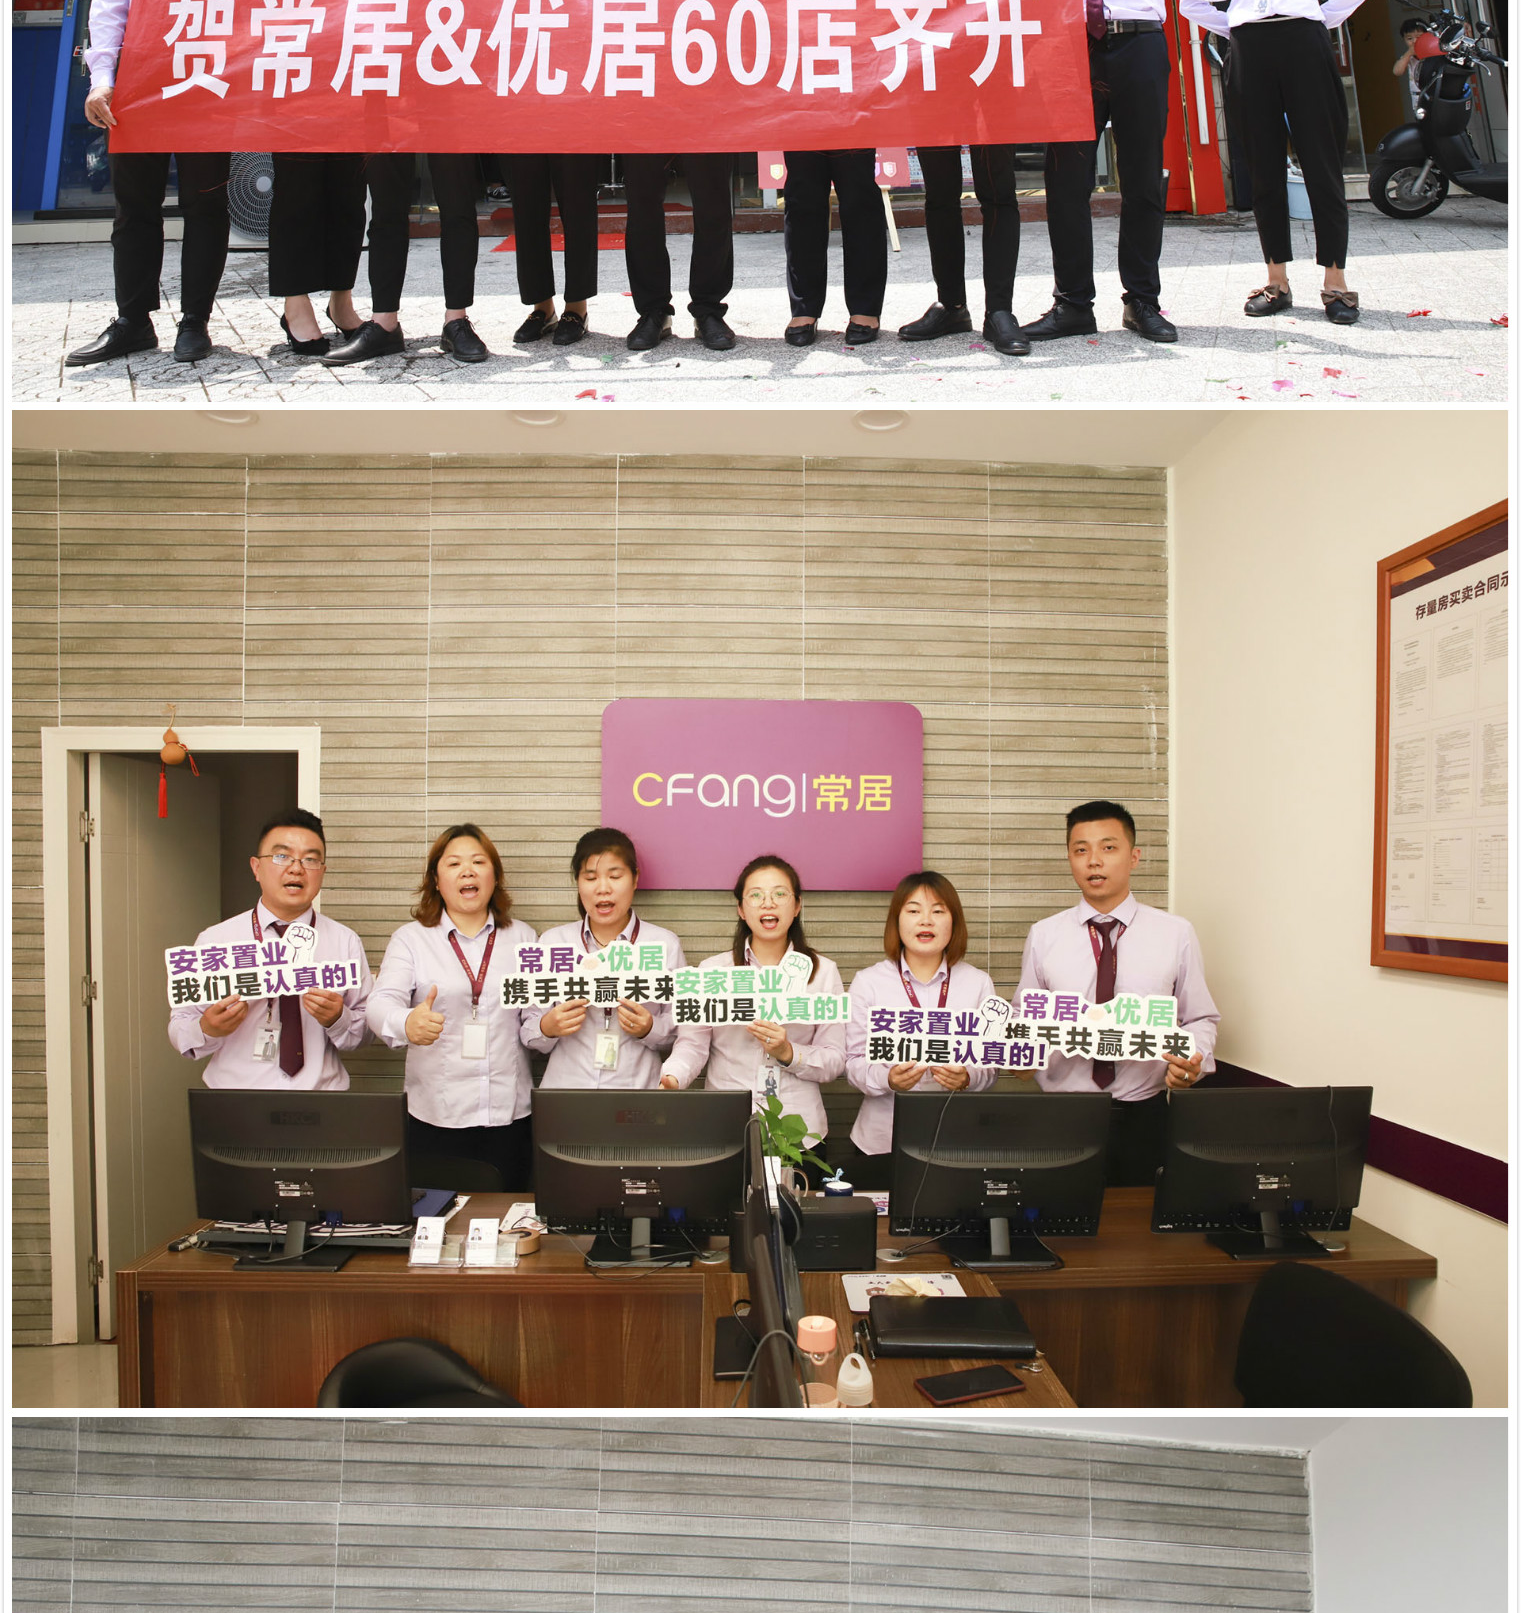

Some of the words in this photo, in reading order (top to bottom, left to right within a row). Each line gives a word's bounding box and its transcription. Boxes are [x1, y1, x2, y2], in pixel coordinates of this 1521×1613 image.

[812, 774, 893, 812] 常居
[169, 941, 288, 975] 安家置业
[518, 947, 574, 974] 常居
[608, 945, 664, 972] 优居
[503, 976, 674, 1005] 携手共赢未来
[676, 969, 784, 995] 安家置业
[870, 1008, 980, 1036] 安家置业
[1023, 993, 1080, 1023] 常居
[1114, 997, 1175, 1027] 优居
